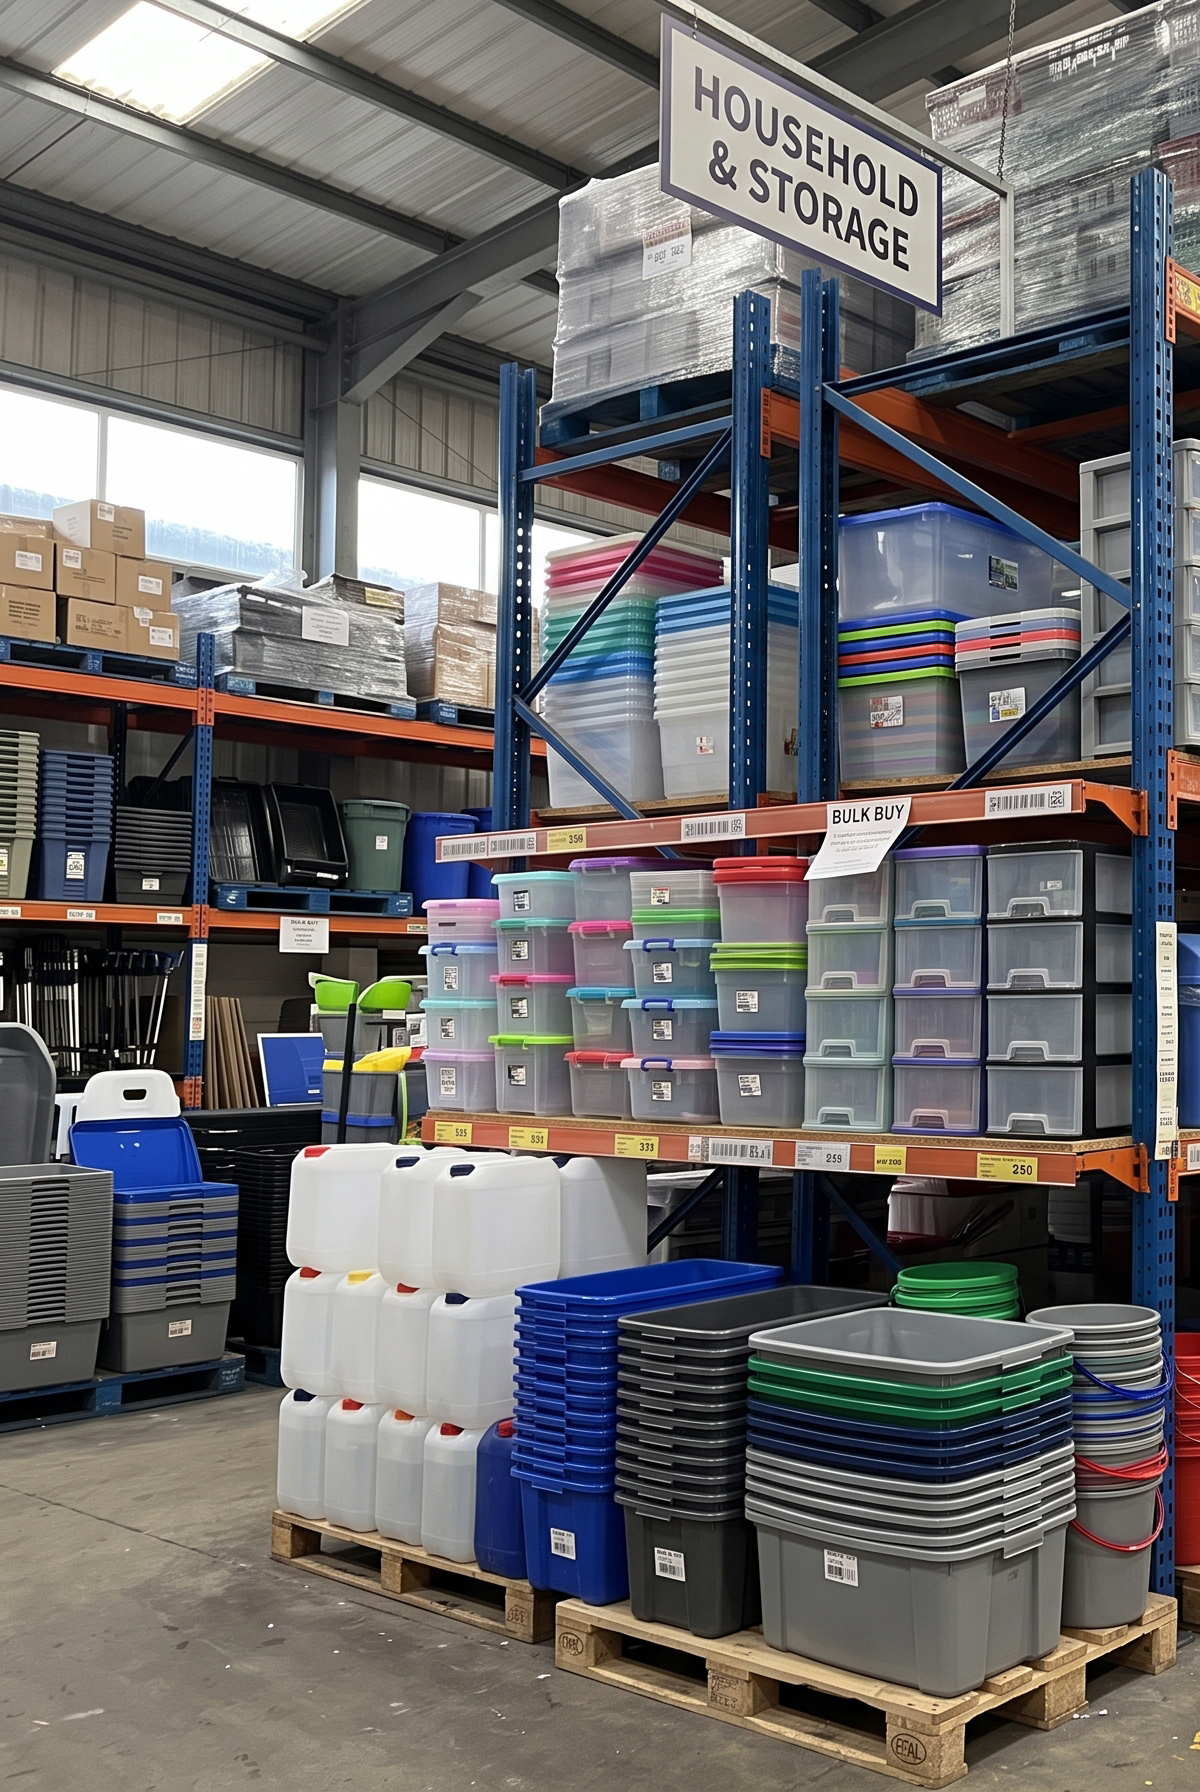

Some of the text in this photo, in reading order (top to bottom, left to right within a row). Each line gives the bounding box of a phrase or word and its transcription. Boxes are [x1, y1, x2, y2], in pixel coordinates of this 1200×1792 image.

[694, 65, 919, 217] HOUSEHOLD
[708, 140, 910, 272] & STORAGE
[832, 803, 905, 825] BULK BUY
[1012, 1164, 1033, 1176] 250
